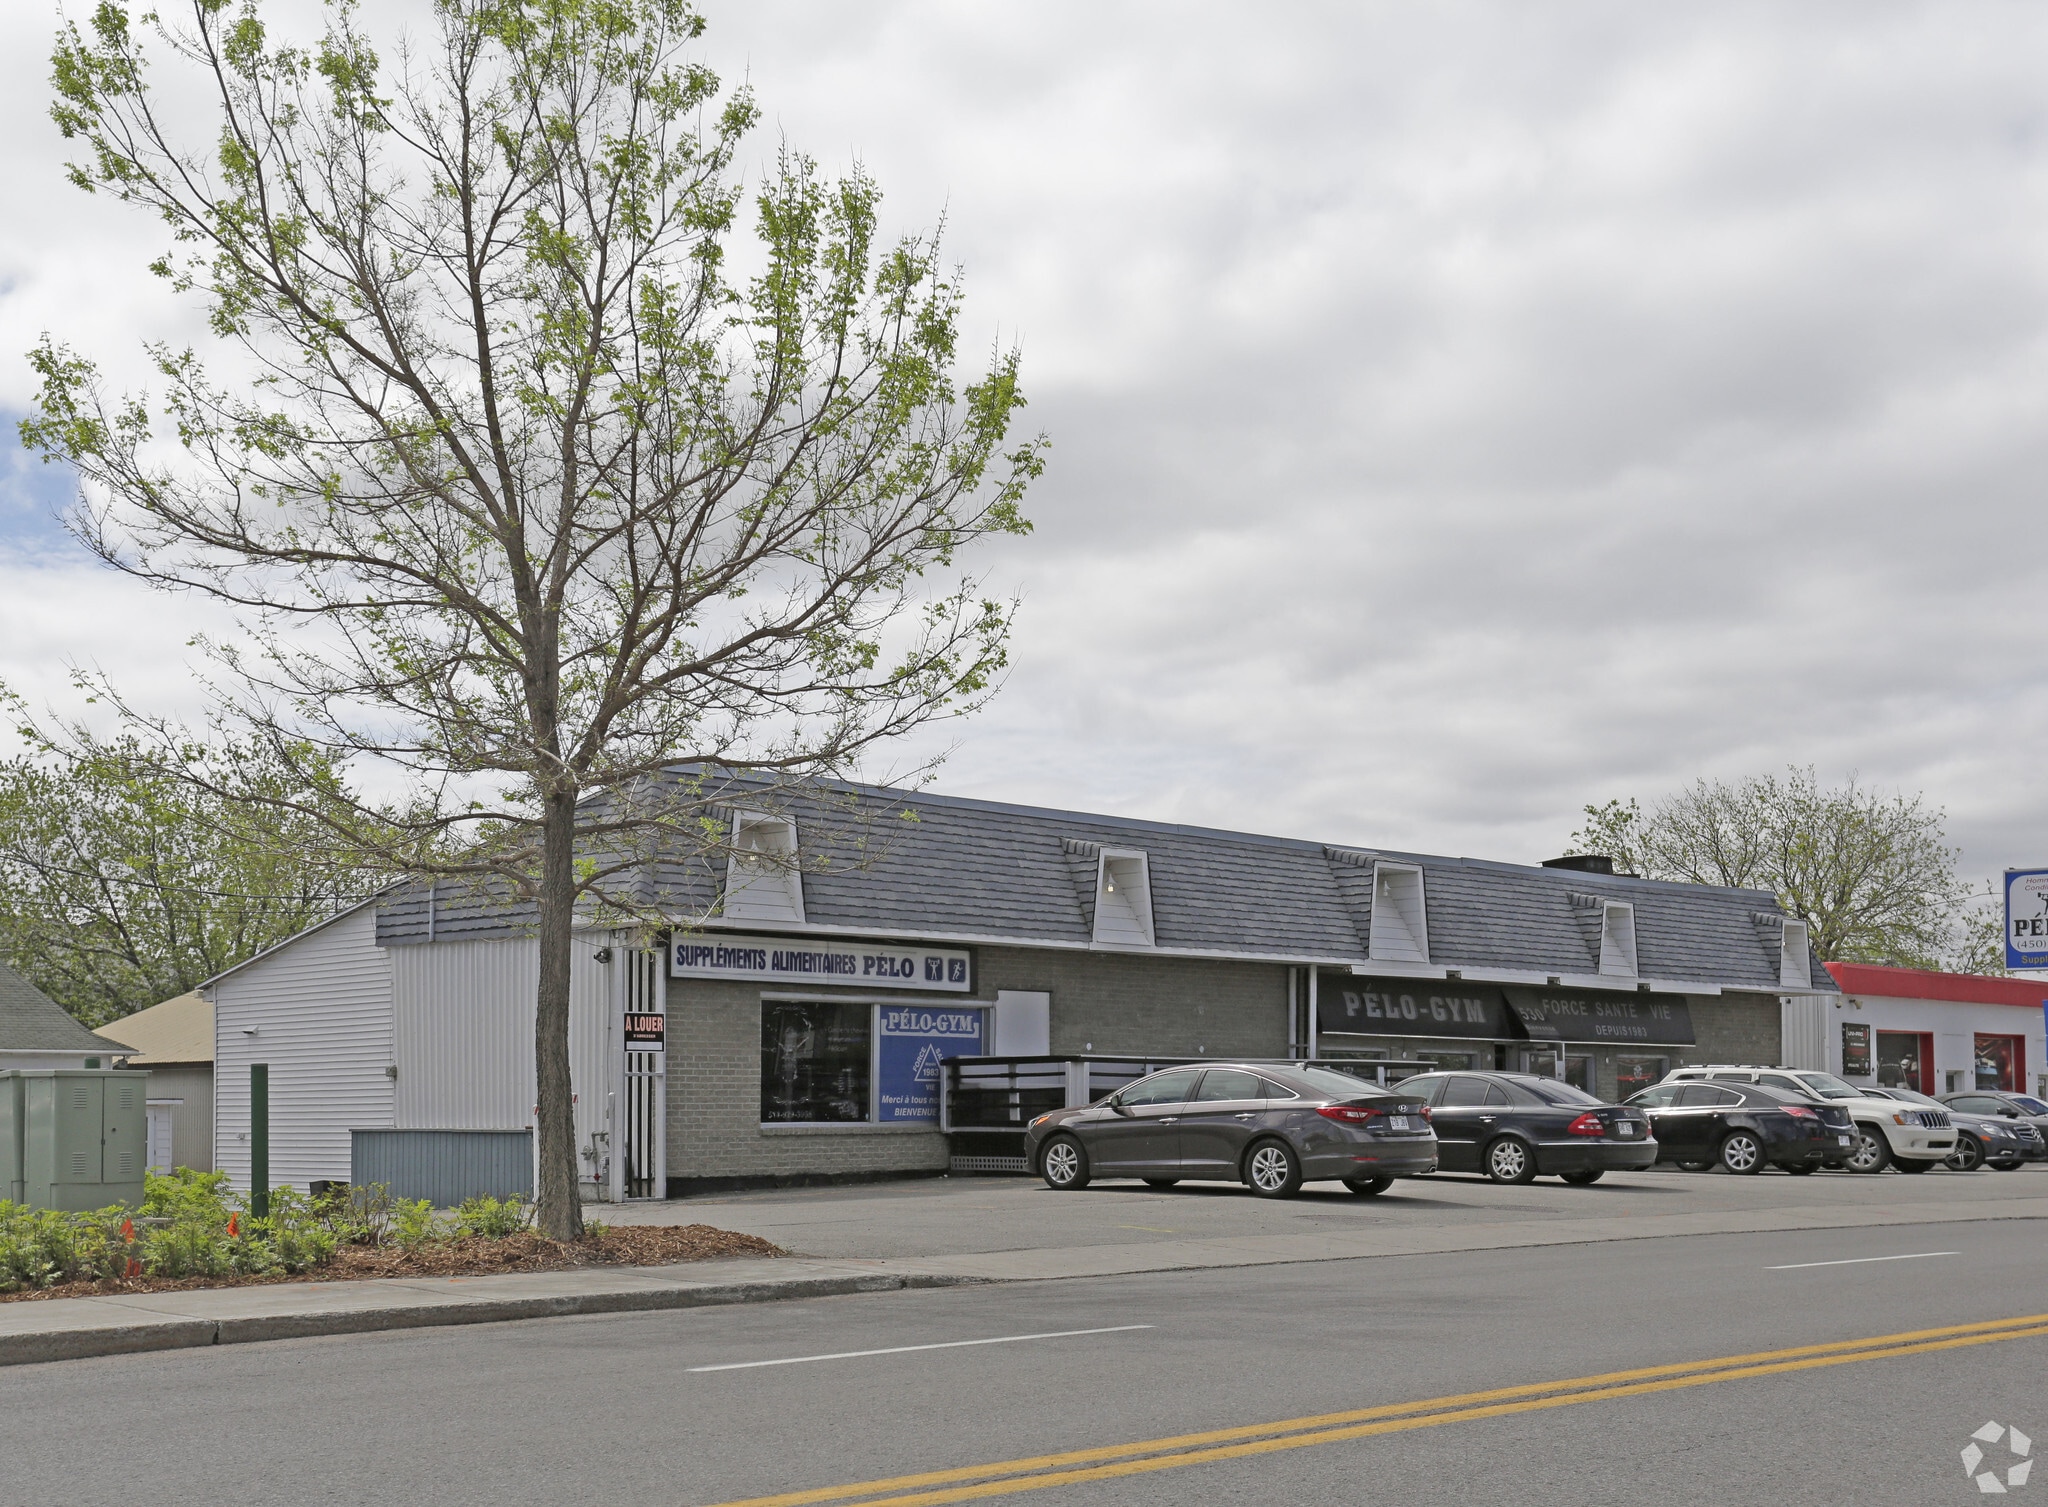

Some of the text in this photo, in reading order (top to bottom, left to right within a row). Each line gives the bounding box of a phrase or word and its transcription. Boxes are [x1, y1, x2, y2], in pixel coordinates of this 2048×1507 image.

[2017, 939, 2047, 950] (450)
[676, 943, 915, 978] SUPPLÉMENTS ALIMENTAIRES PÉLO
[1342, 982, 1488, 1024] PÉLO-GYM
[1542, 999, 1588, 1016] FORCE
[1650, 1005, 1672, 1020] VIE
[887, 1008, 974, 1032] PÉLO-GYM
[1518, 1006, 1545, 1021] 530
[634, 1016, 663, 1032] LOUER
[912, 1046, 927, 1072] FORCE
[923, 1068, 940, 1076] 1983
[881, 1095, 904, 1104] Merci
[904, 1094, 910, 1104] à
[911, 1095, 928, 1104] tous
[894, 1107, 938, 1117] BIENVENUE
